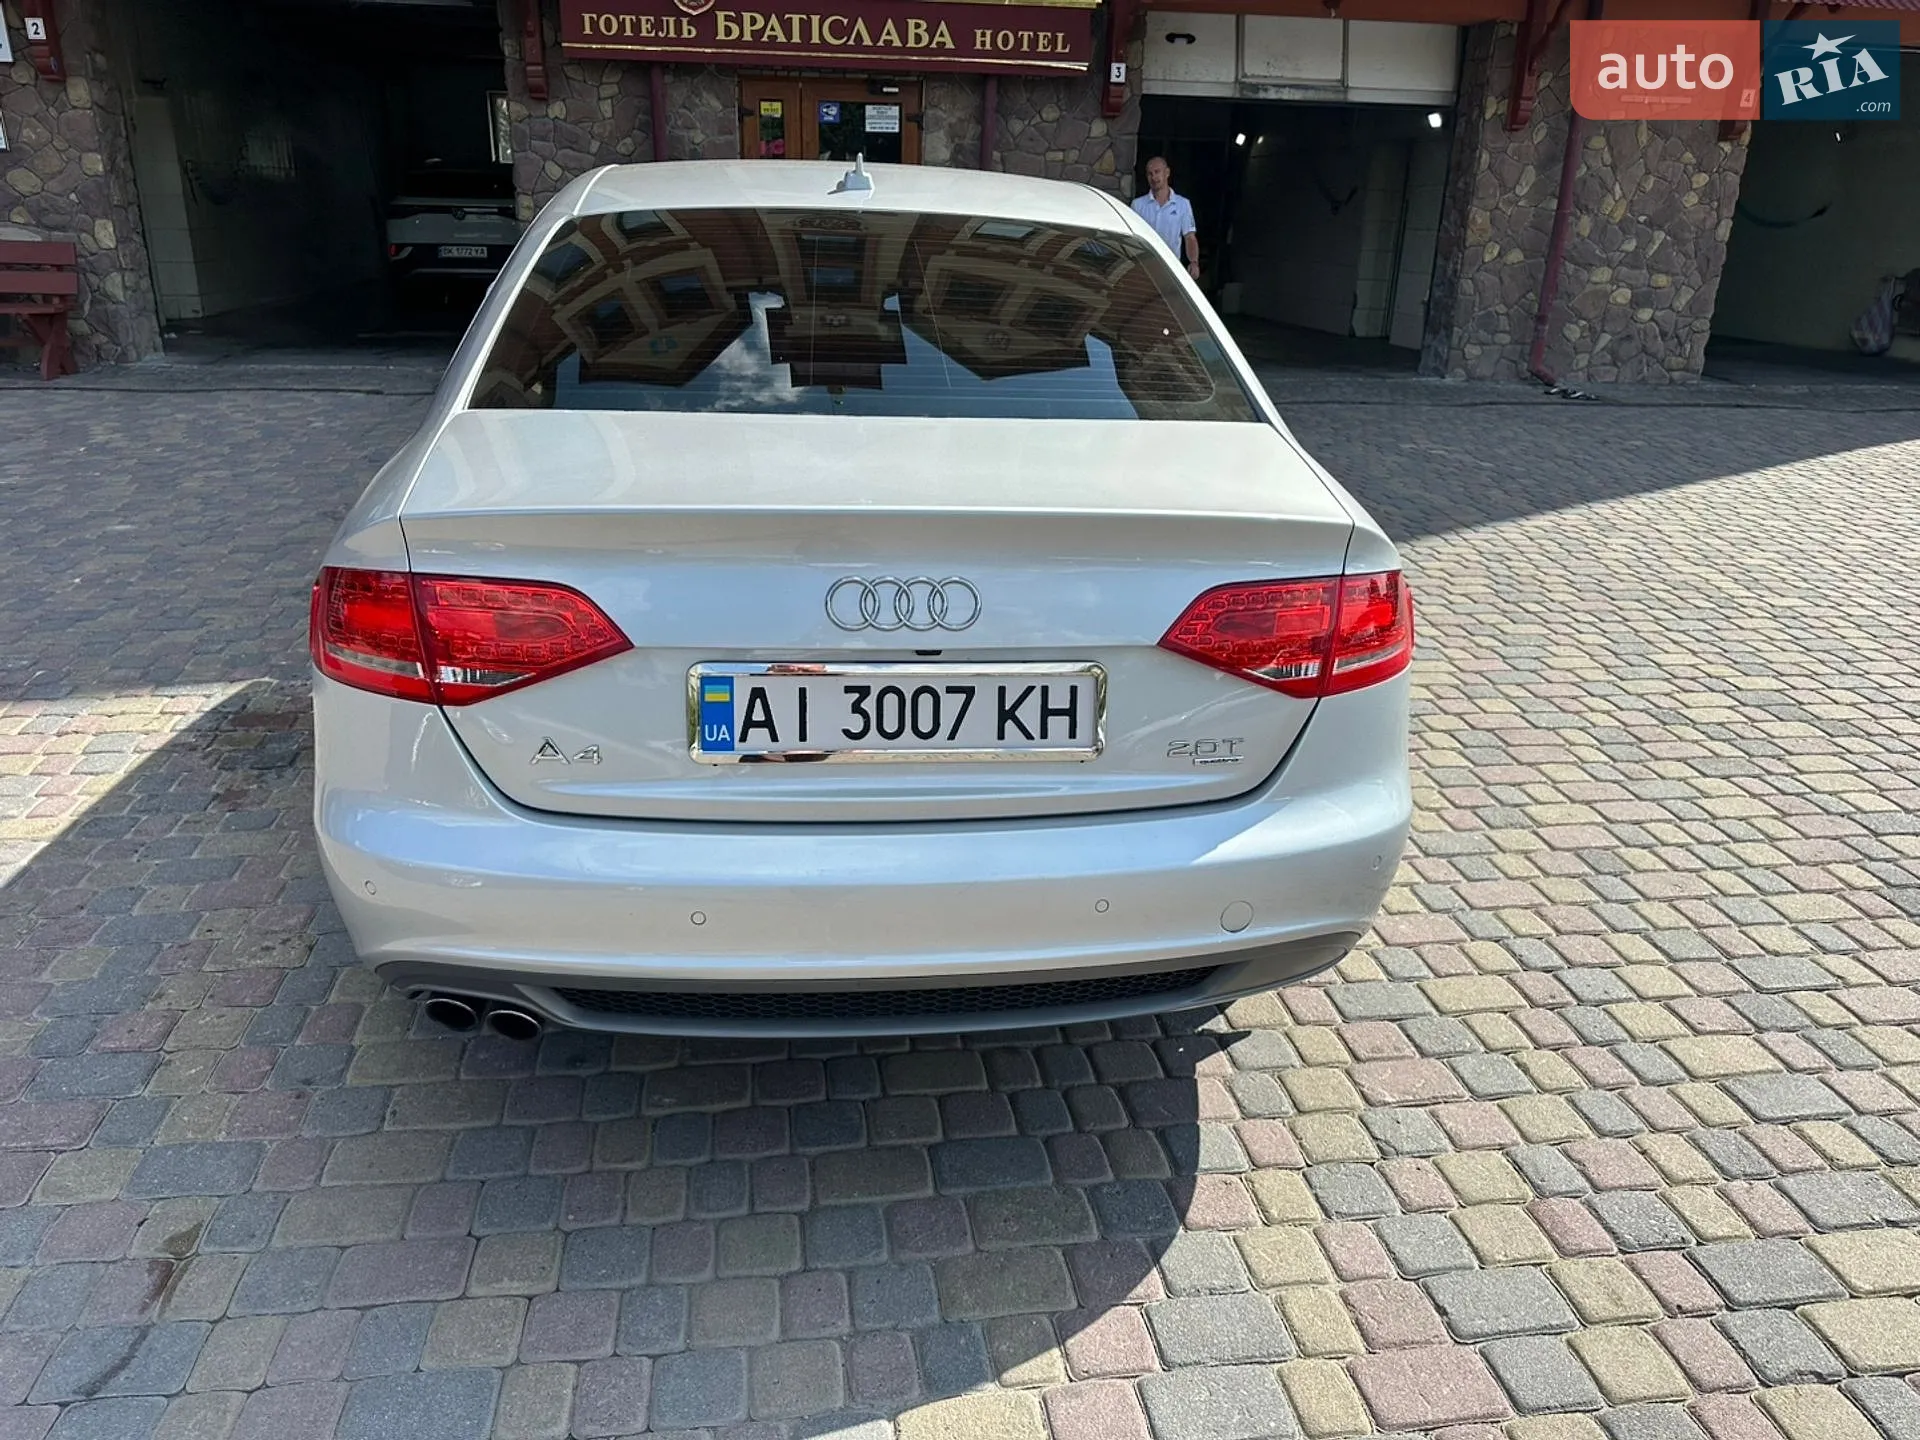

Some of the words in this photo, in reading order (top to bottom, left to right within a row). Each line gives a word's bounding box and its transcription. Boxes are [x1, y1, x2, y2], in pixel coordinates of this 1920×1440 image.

[31, 22, 40, 35] 2
[582, 13, 697, 39] ГОТЕЛЬ
[715, 10, 956, 49] БРАТІСЛАВА
[973, 28, 1071, 54] HOTEL
[738, 686, 808, 743] AI
[841, 685, 976, 740] 3007
[997, 685, 1078, 740] KH
[704, 724, 731, 742] UA
